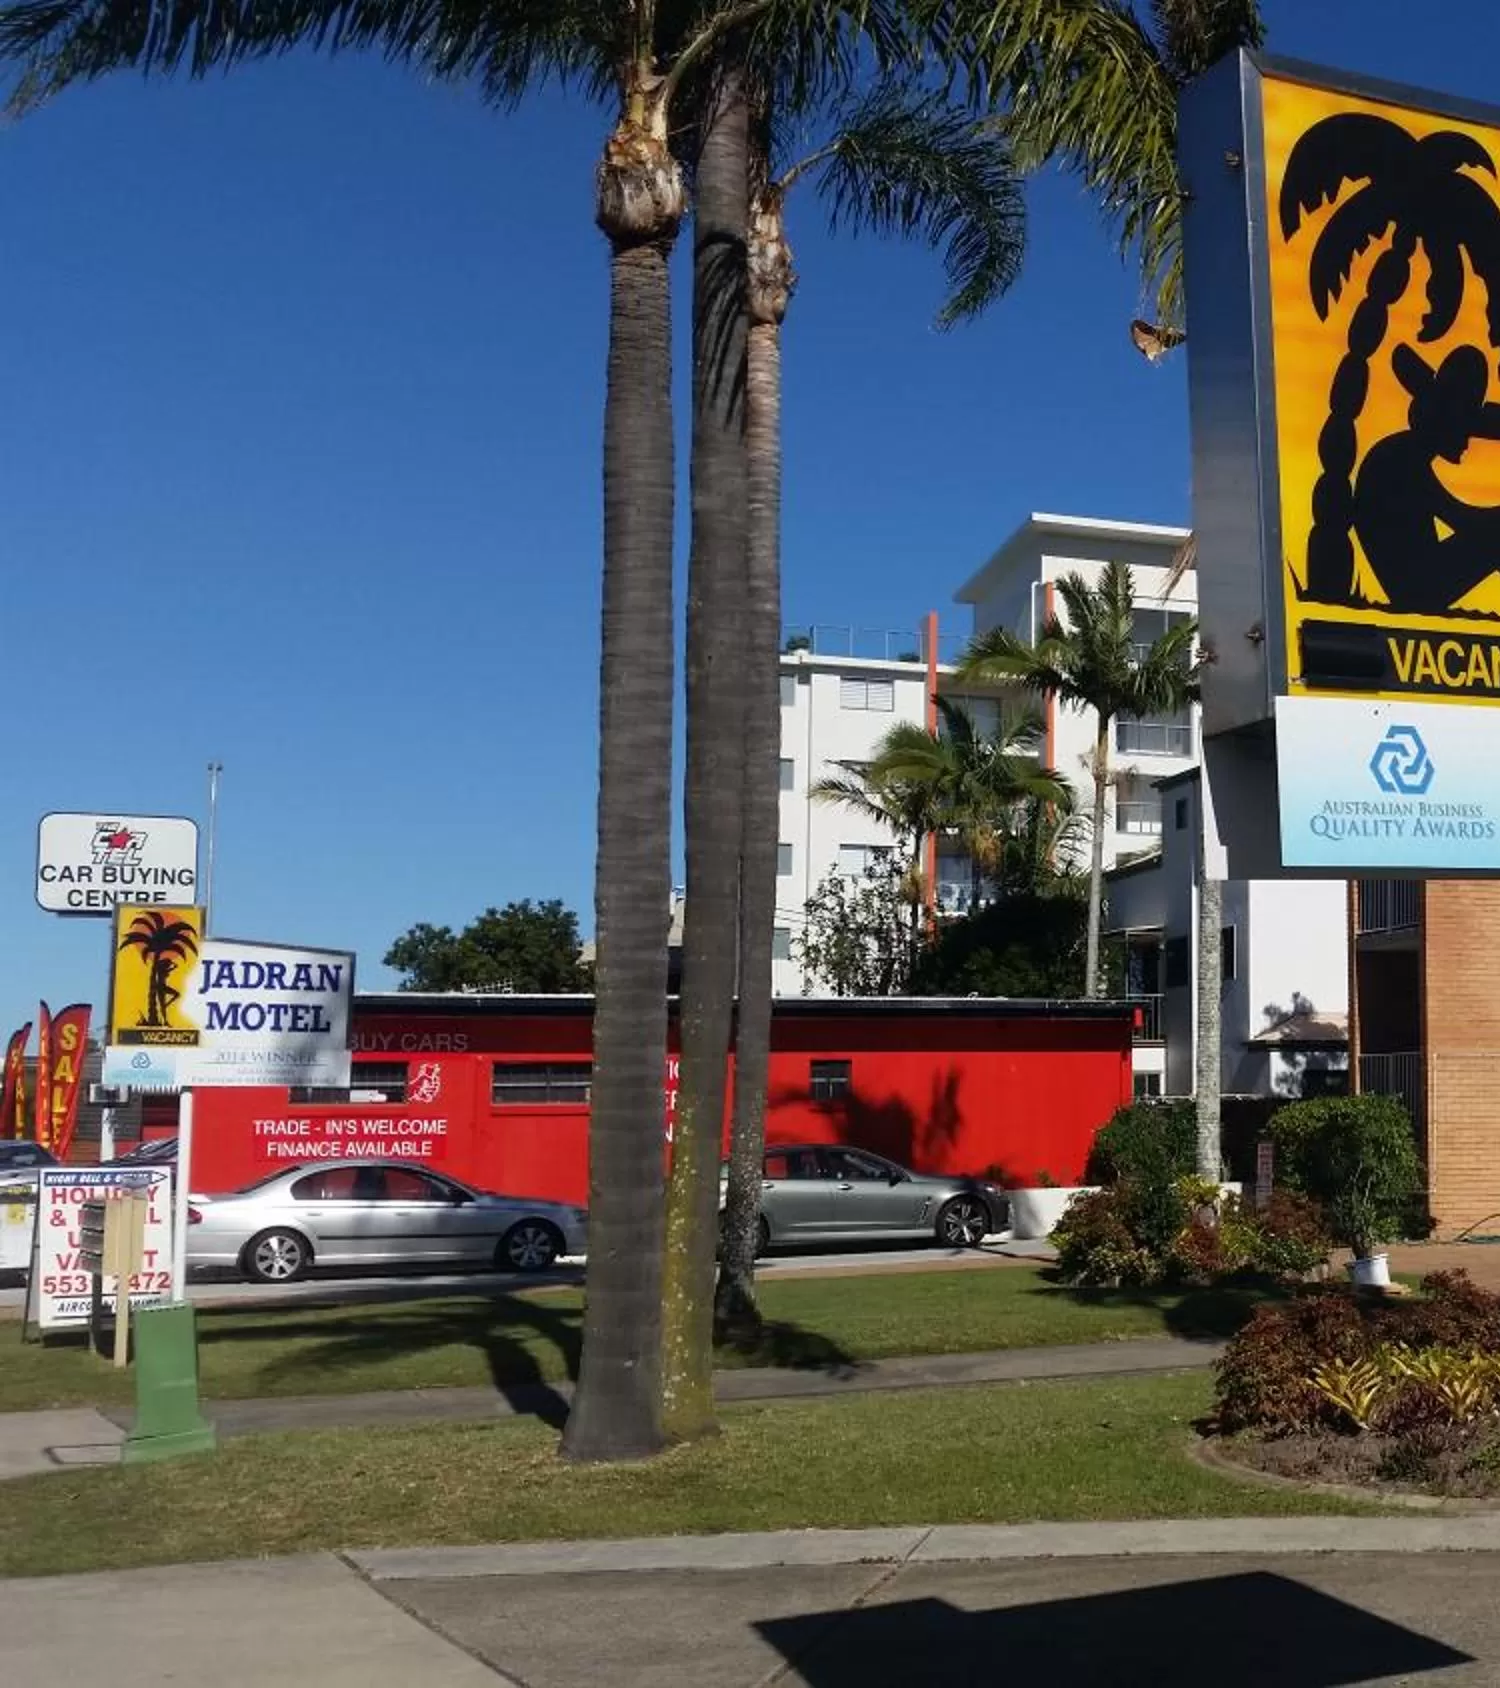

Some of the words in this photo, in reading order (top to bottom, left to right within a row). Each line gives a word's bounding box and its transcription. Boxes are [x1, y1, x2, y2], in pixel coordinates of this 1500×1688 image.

[1310, 814, 1405, 841] QUALITY
[1412, 817, 1496, 840] AWARDS
[40, 864, 93, 883] CAR
[102, 866, 195, 886] BUYING
[199, 959, 343, 994] JADRAN
[205, 1002, 331, 1033] MOTEL
[140, 1031, 196, 1044] VACANCY
[401, 1033, 468, 1051] CARS
[253, 1119, 310, 1135] TRADE
[362, 1119, 447, 1135] WELCOME
[267, 1141, 341, 1157] FINANCE
[344, 1141, 432, 1157] AVAILABLE
